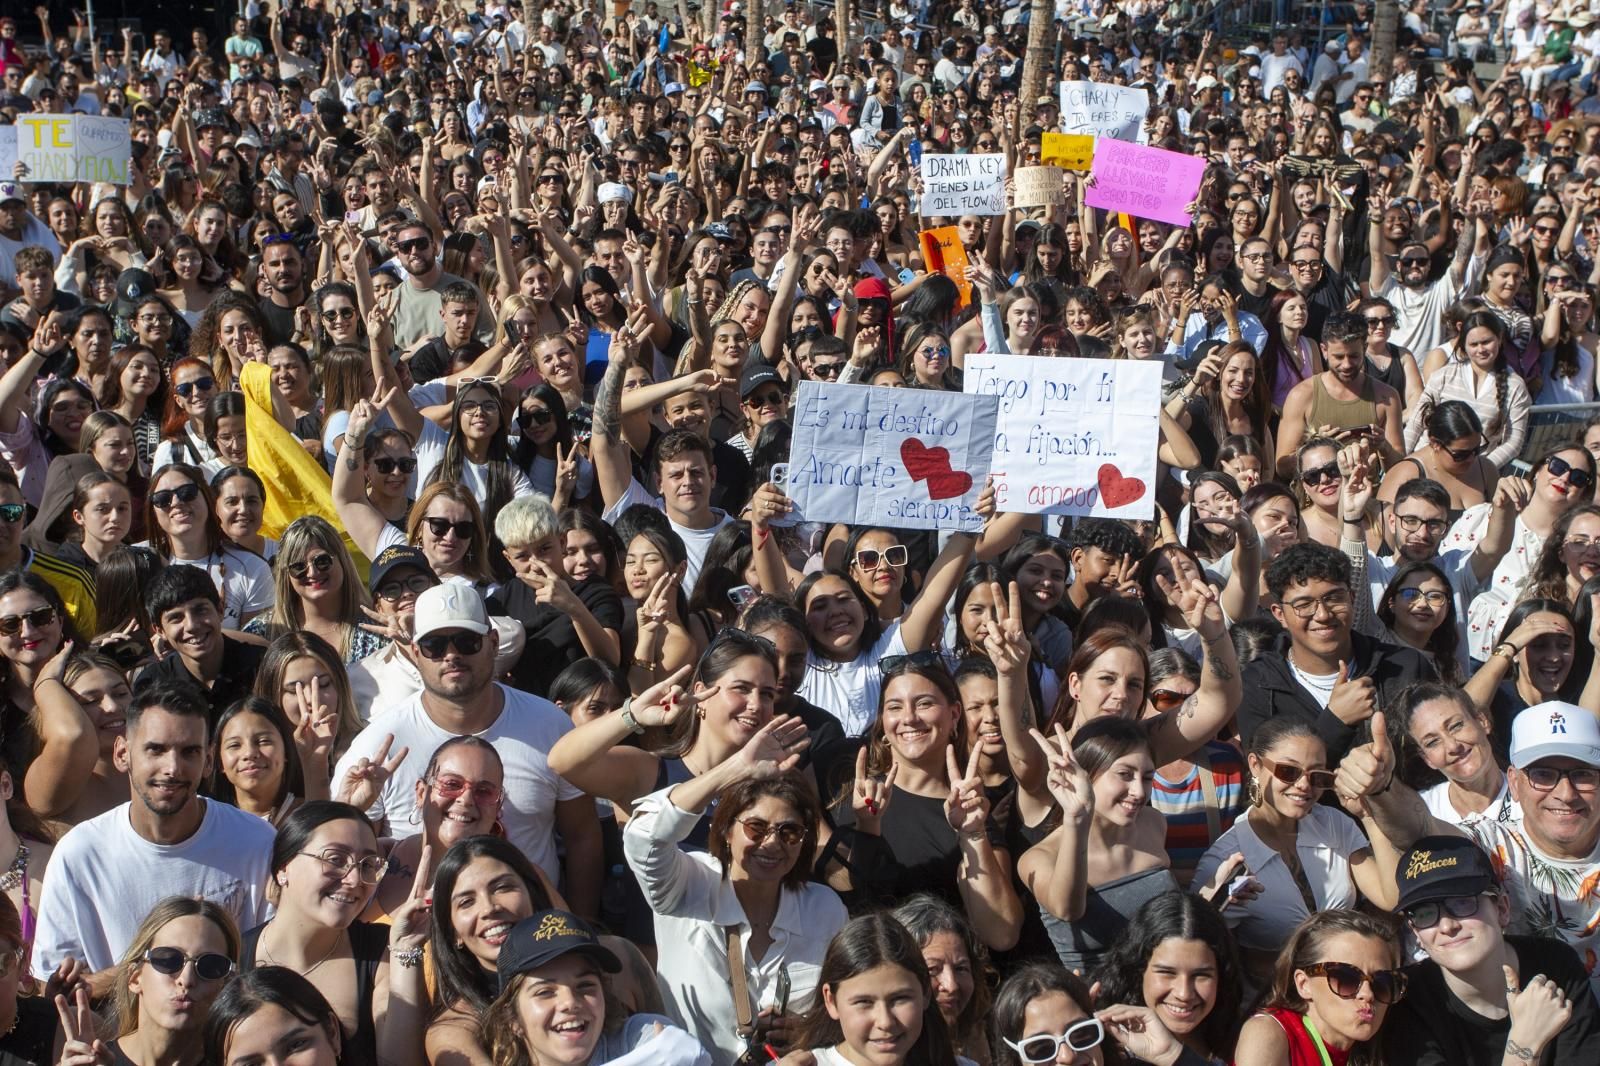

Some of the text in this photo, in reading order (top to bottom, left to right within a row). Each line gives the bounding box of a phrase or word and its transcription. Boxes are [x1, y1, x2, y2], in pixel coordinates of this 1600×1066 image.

[1091, 110, 1118, 122] ERES
[23, 119, 73, 148] TE
[927, 158, 1002, 177] DRAMA KEY
[973, 181, 984, 191] LA
[1102, 165, 1168, 193] LLEVAME
[933, 195, 988, 209] DEL FLOW
[970, 366, 1113, 416] Tengo por ti
[799, 396, 958, 436] Es mi destino
[1025, 424, 1117, 466] fijación...
[791, 454, 896, 489] Amarte
[1028, 485, 1098, 508] amooo
[888, 496, 982, 528] siempre...
[1409, 850, 1431, 867] Soy
[1413, 857, 1457, 879] Princess
[540, 914, 567, 929] Soy
[533, 928, 546, 941] Tu
